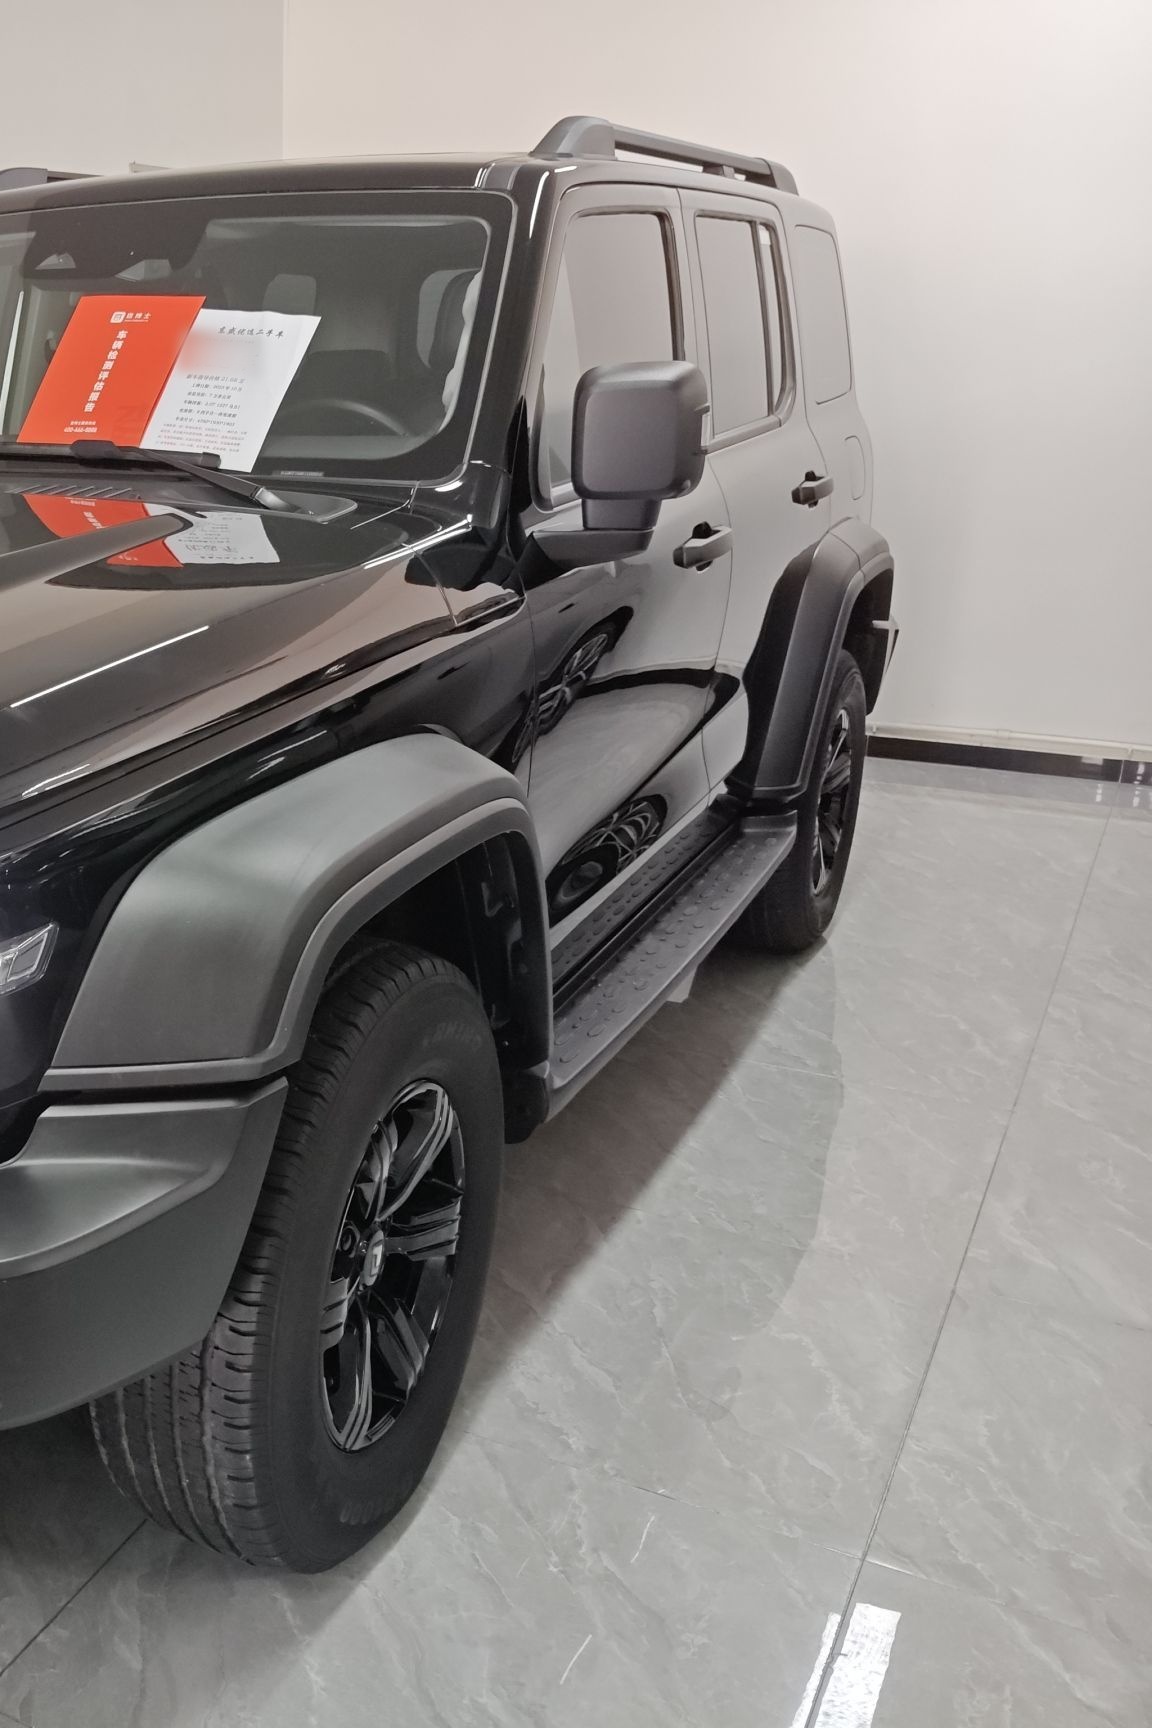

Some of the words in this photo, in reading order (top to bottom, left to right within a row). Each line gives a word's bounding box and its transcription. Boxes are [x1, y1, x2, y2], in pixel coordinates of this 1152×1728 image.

[84, 330, 128, 413] 车辆检测评估报告
